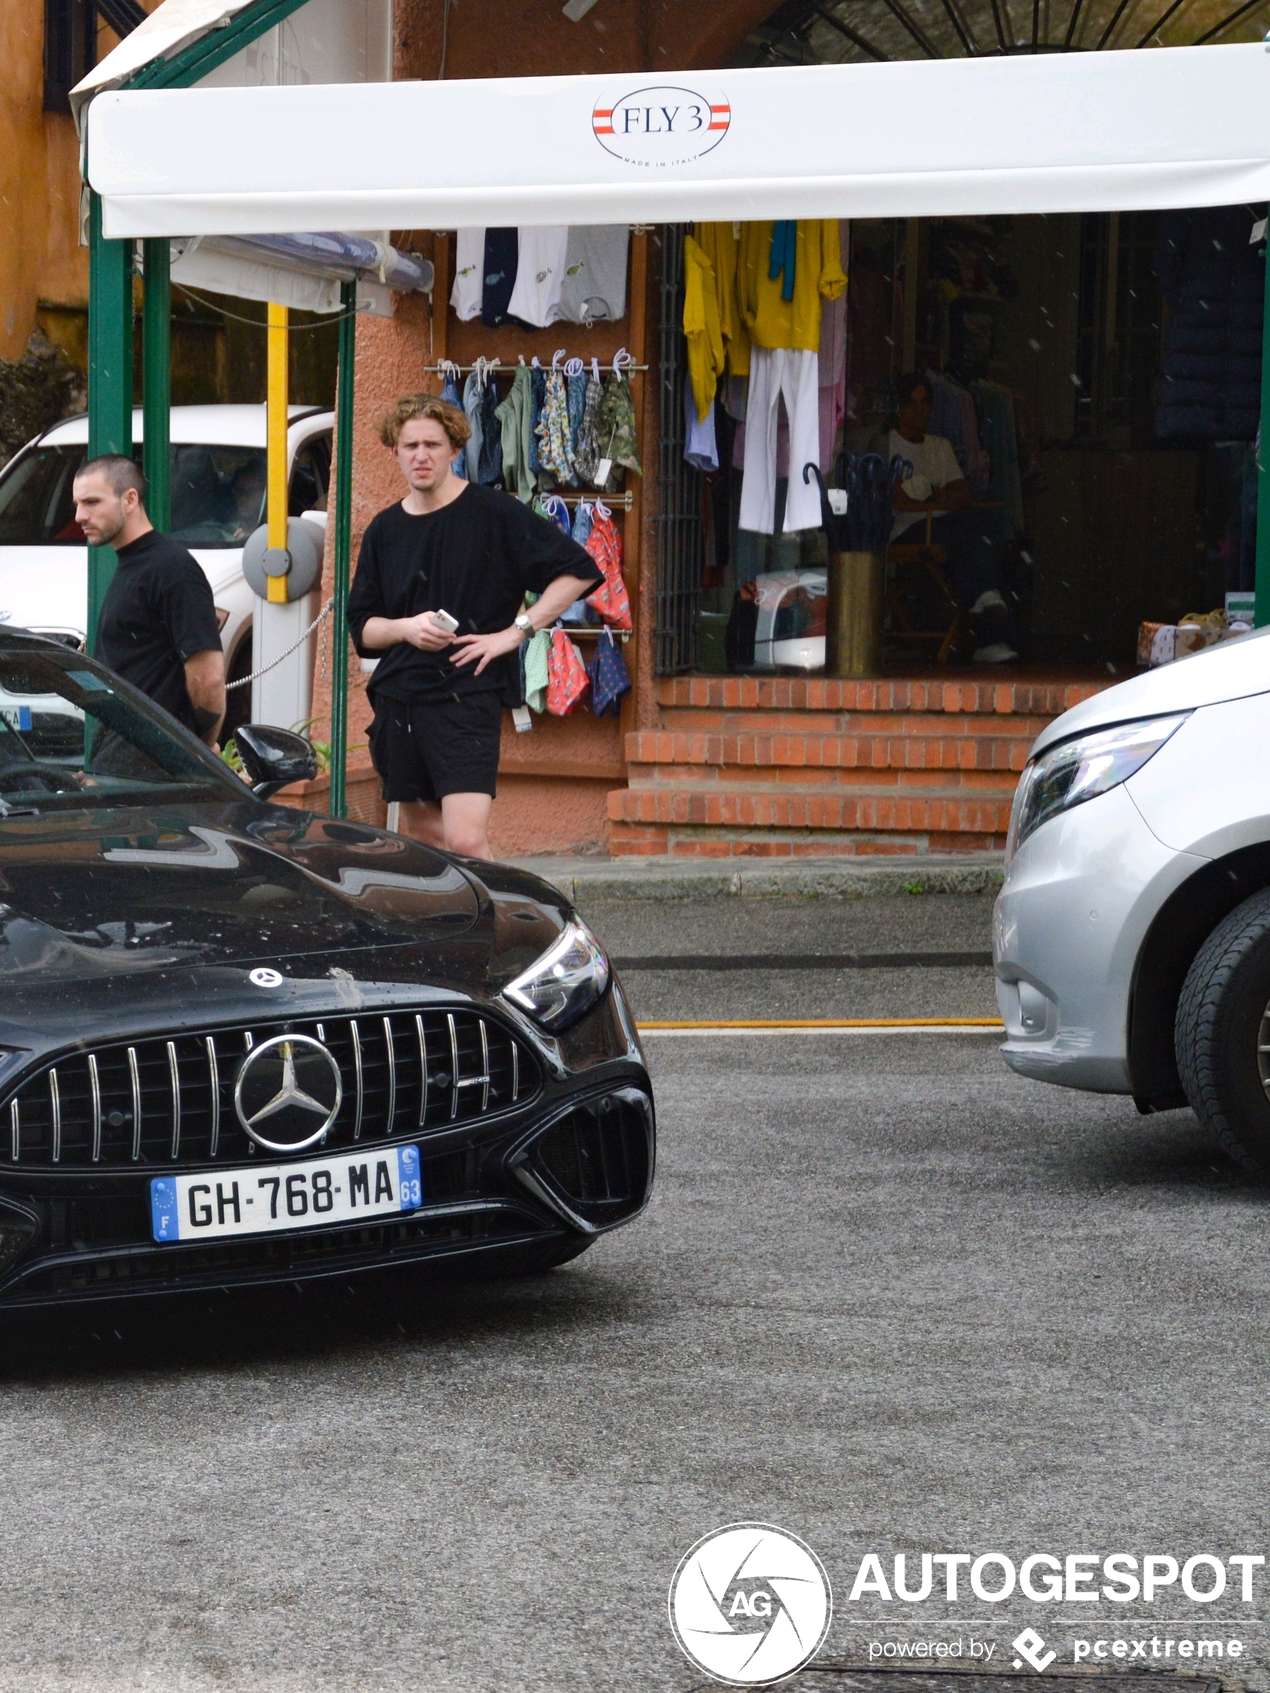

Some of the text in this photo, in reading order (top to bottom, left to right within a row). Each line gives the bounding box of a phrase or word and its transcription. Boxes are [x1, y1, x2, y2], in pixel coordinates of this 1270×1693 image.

[621, 105, 703, 134] FLY 3
[624, 157, 650, 167] MADE
[671, 155, 698, 166] ITALY
[161, 1216, 170, 1229] F
[188, 1160, 394, 1228] GH-768-MA
[400, 1179, 421, 1202] 63
